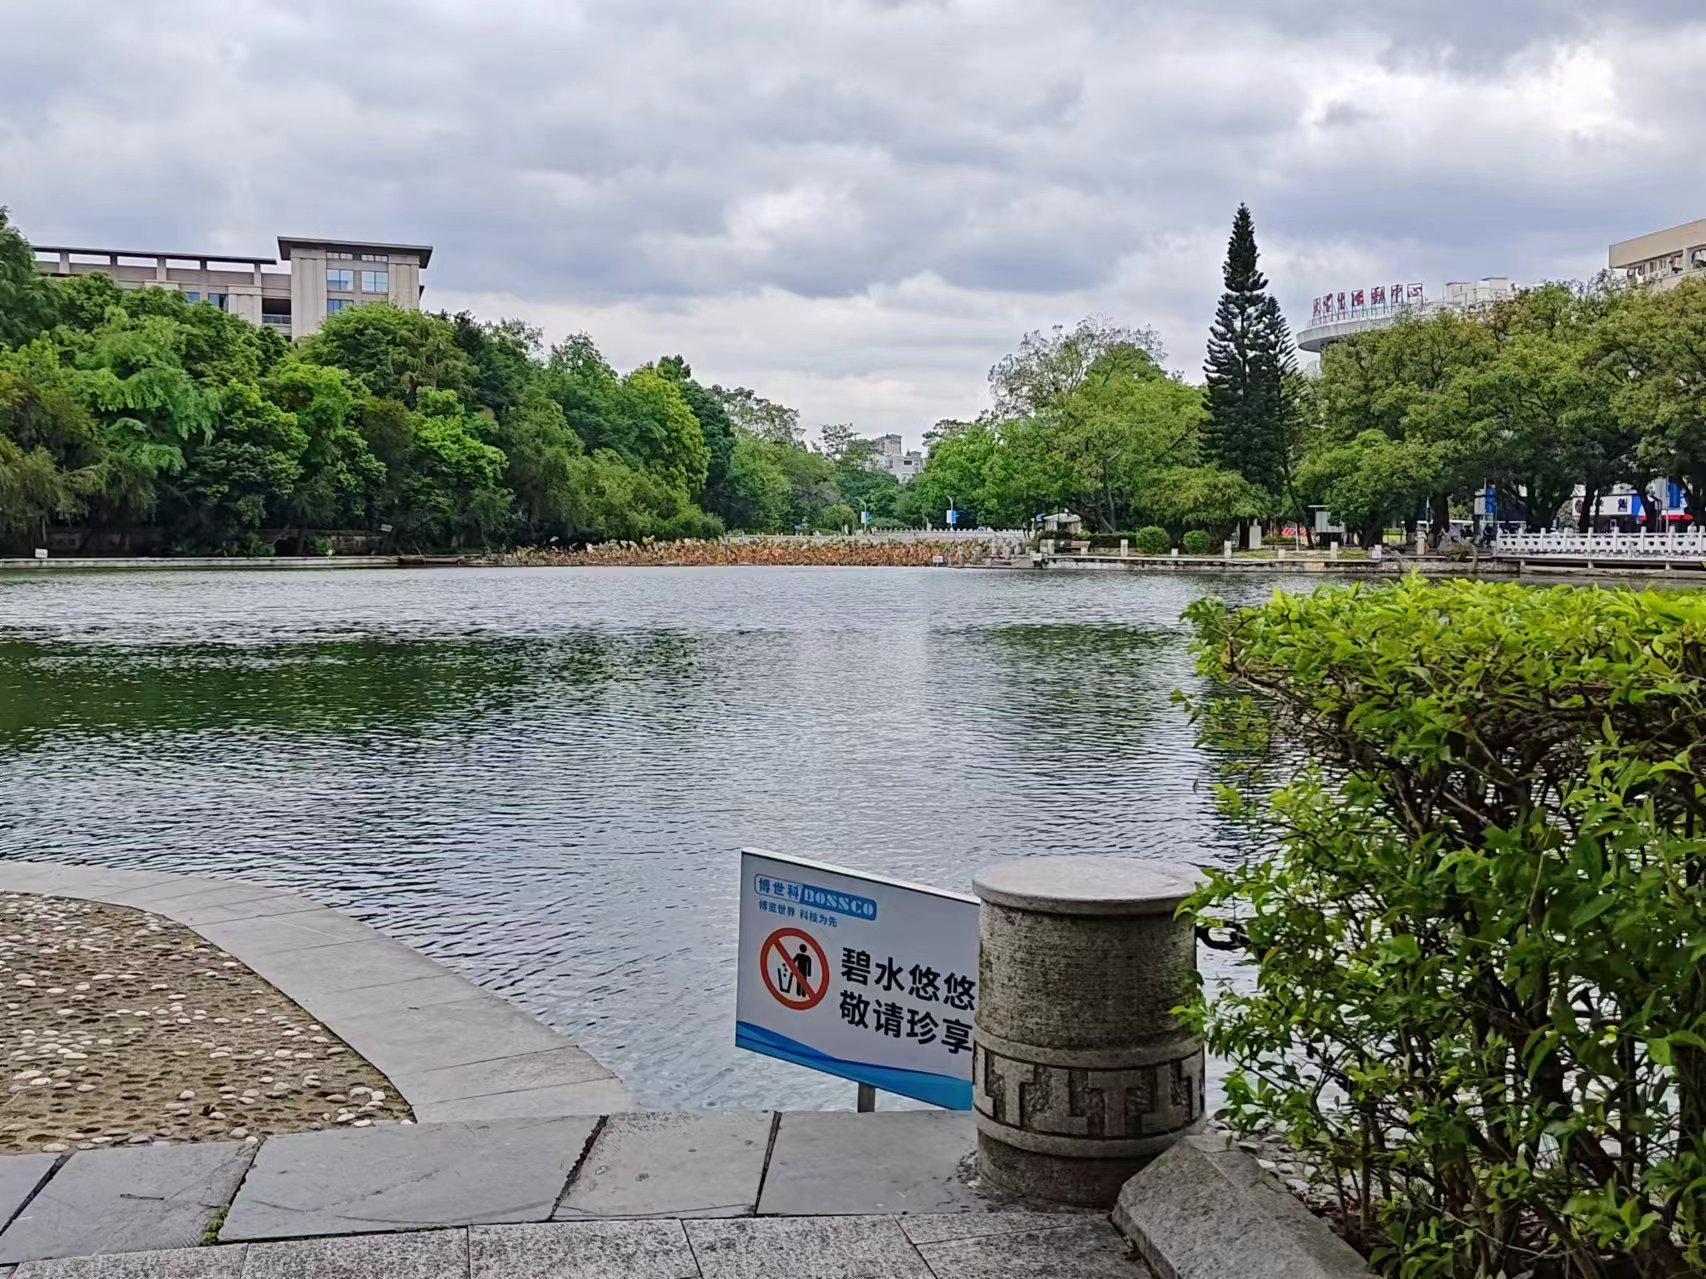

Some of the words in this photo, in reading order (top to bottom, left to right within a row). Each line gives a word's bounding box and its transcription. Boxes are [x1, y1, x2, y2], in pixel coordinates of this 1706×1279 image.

[758, 878, 800, 900] 博世科
[803, 888, 874, 916] BOSSCO
[758, 900, 796, 917] 博览世界
[799, 909, 838, 928] 科技为先
[840, 947, 976, 1011] 碧水悠悠
[839, 990, 973, 1055] 敬请珍享
